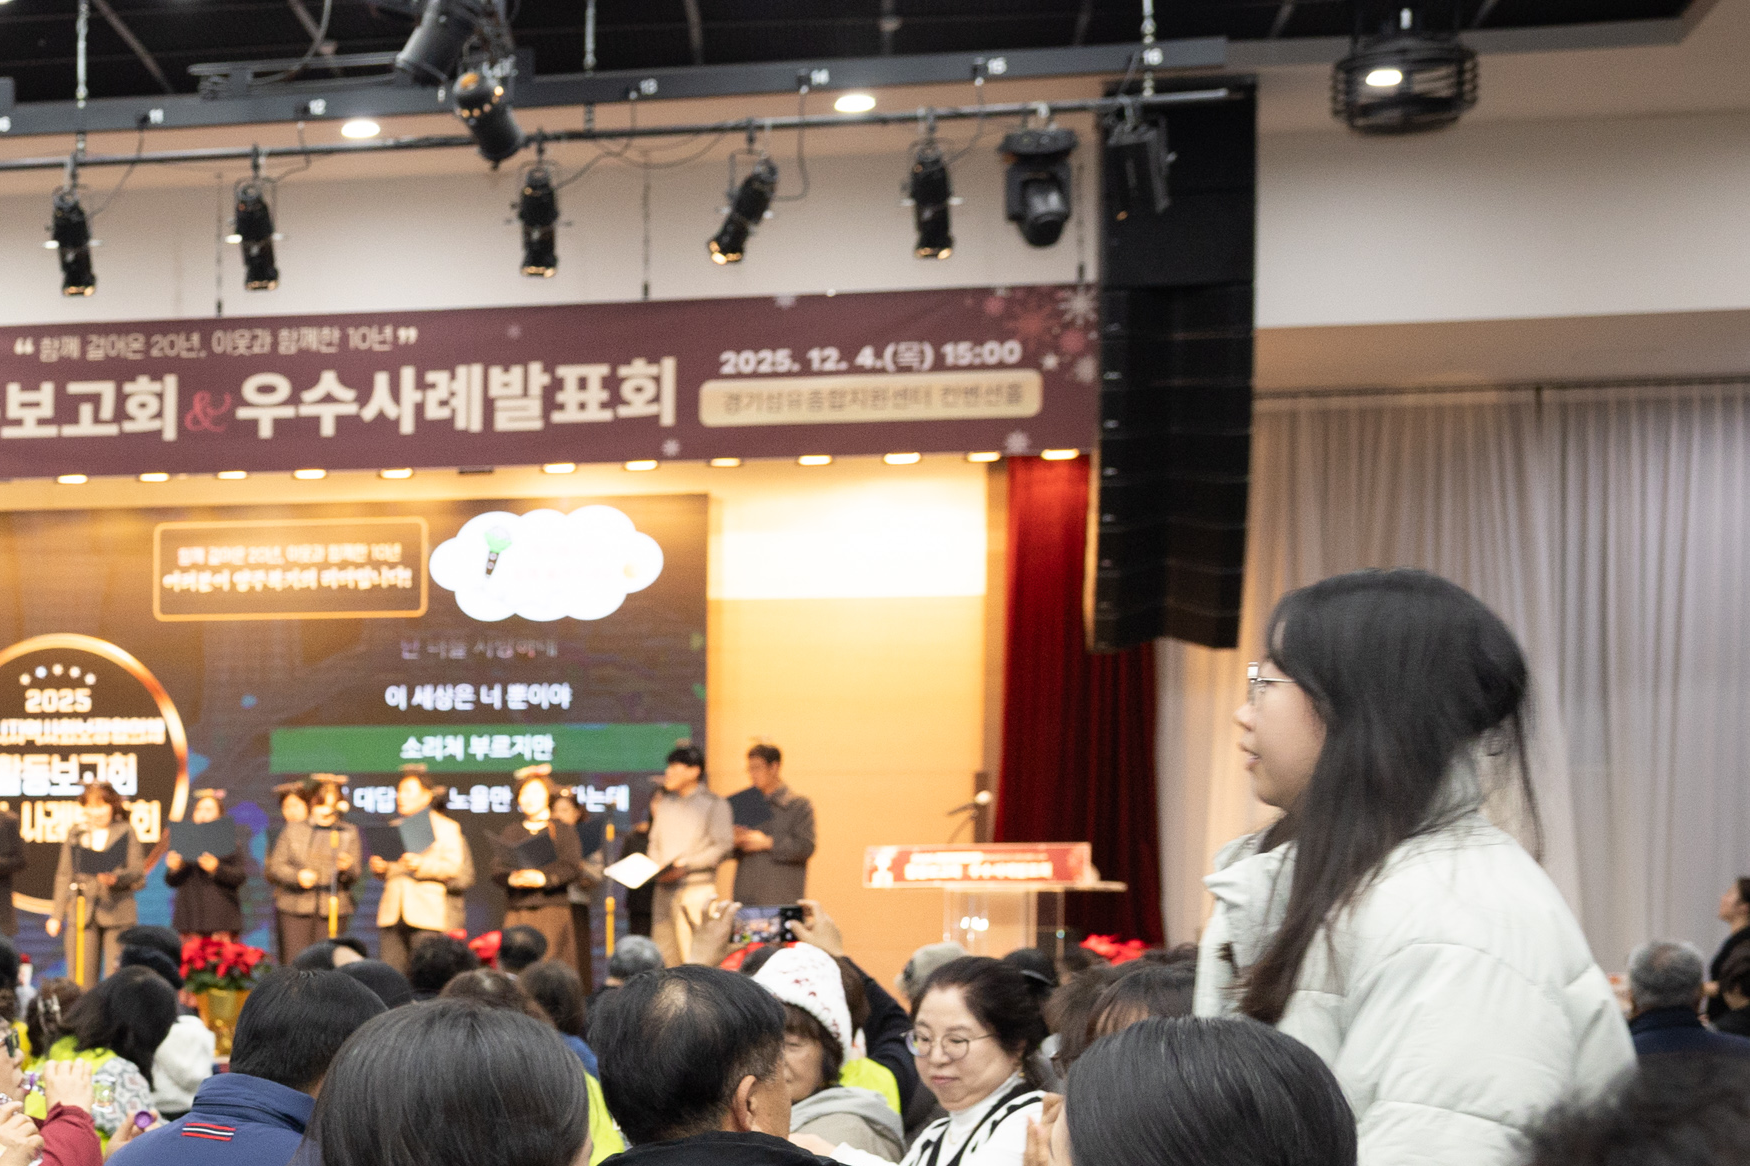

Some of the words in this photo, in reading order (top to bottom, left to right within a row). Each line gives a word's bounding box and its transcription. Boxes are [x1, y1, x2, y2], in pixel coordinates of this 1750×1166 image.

[85, 333, 146, 360] 걸어온
[211, 328, 272, 356] 이웃과
[278, 327, 341, 355] 함께한
[940, 339, 1024, 366] 15:00
[183, 389, 233, 433] &
[234, 355, 677, 440] 우수사례발표회
[24, 688, 92, 714] 2025
[384, 684, 408, 711] 이
[411, 682, 477, 712] 세상은
[479, 682, 503, 711] 너
[506, 682, 573, 711] 뿐이야
[467, 732, 556, 762] 부르지만
